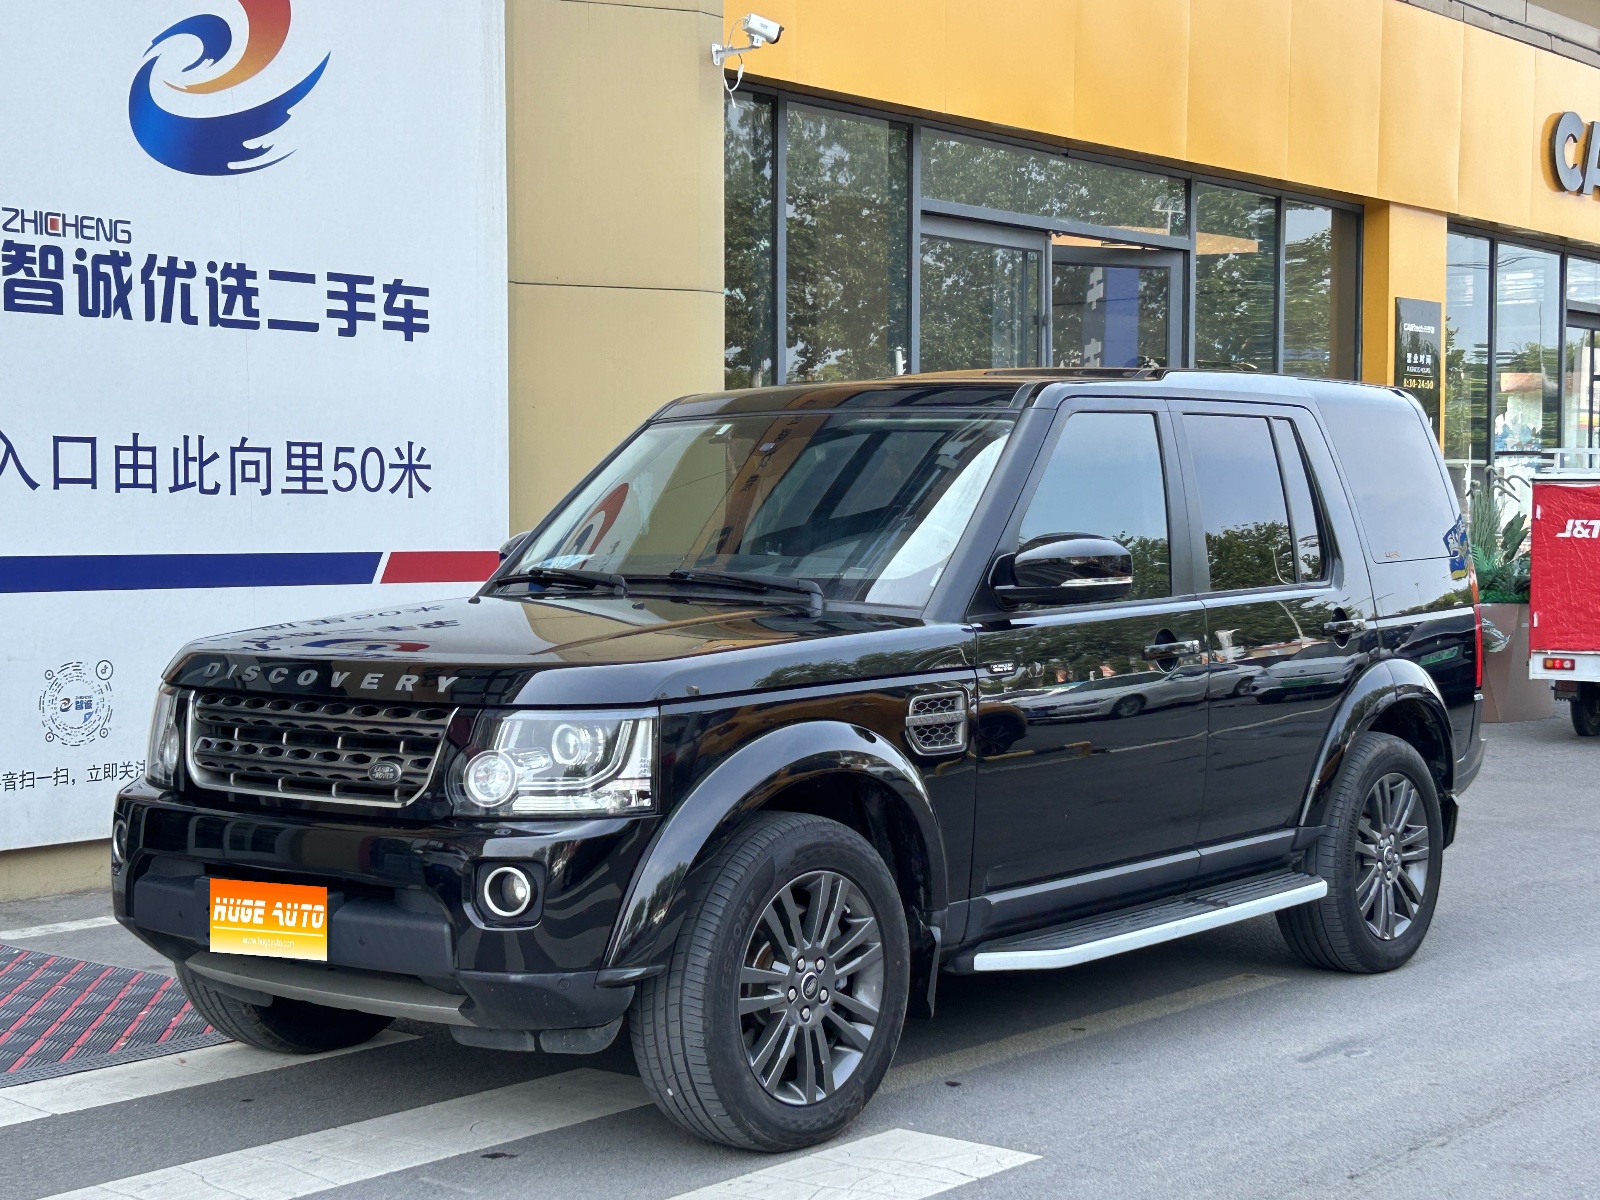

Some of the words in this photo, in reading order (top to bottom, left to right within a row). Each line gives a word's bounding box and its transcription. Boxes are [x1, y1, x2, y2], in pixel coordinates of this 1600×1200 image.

[1, 207, 132, 245] ZHICHENG
[1, 239, 430, 342] 智诚优选二手车
[0, 431, 432, 499] 入口由此向里50米
[203, 662, 459, 693] DISCOVERY
